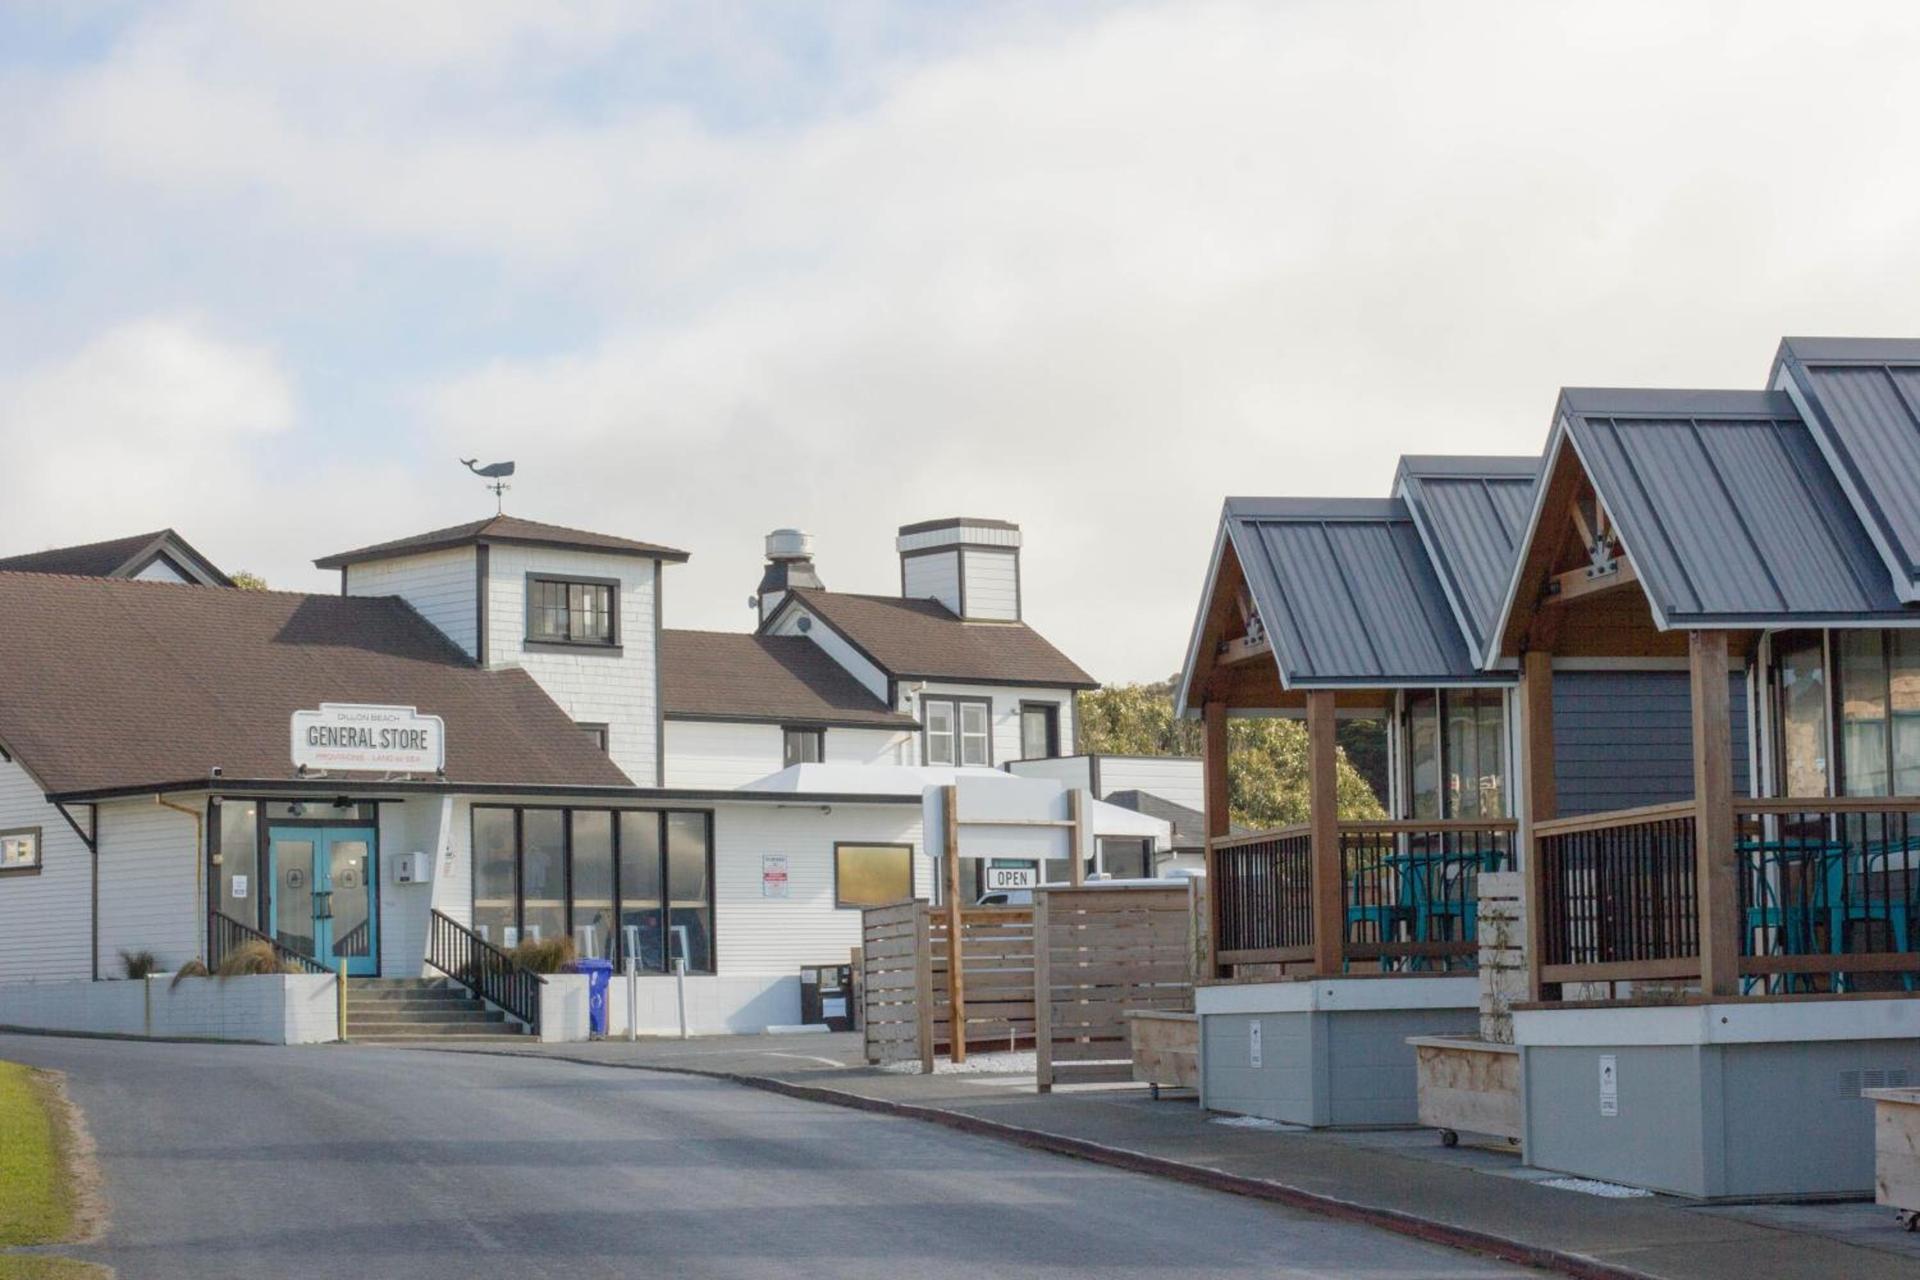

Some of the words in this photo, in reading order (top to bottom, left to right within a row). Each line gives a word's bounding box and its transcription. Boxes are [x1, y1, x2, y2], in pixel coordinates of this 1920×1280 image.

[337, 713, 369, 721] DILLON
[308, 725, 377, 748] GENERAL
[381, 728, 428, 750] STORE
[997, 871, 1028, 886] OPEN
